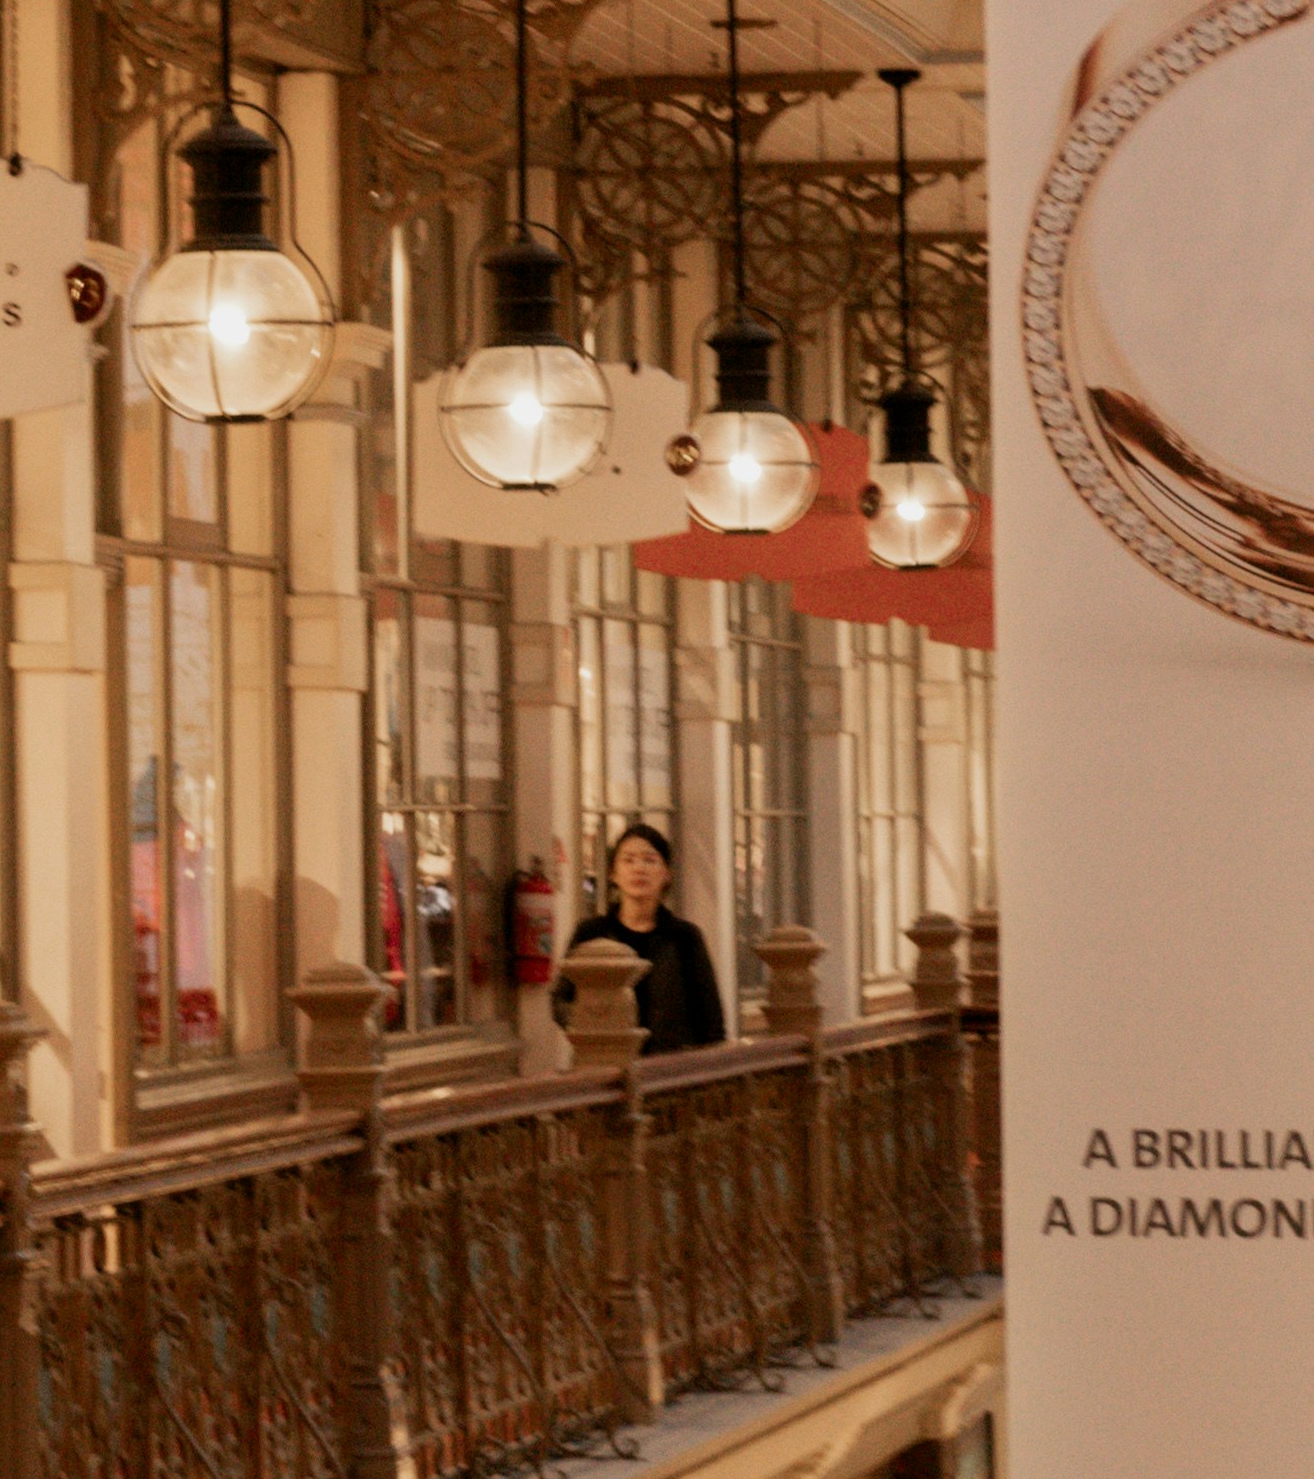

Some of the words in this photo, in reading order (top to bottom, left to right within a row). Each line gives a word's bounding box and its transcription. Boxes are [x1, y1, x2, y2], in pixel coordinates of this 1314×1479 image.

[1081, 1127, 1120, 1170] A
[1041, 1196, 1077, 1237] A
[1089, 1196, 1314, 1240] DIAMON
